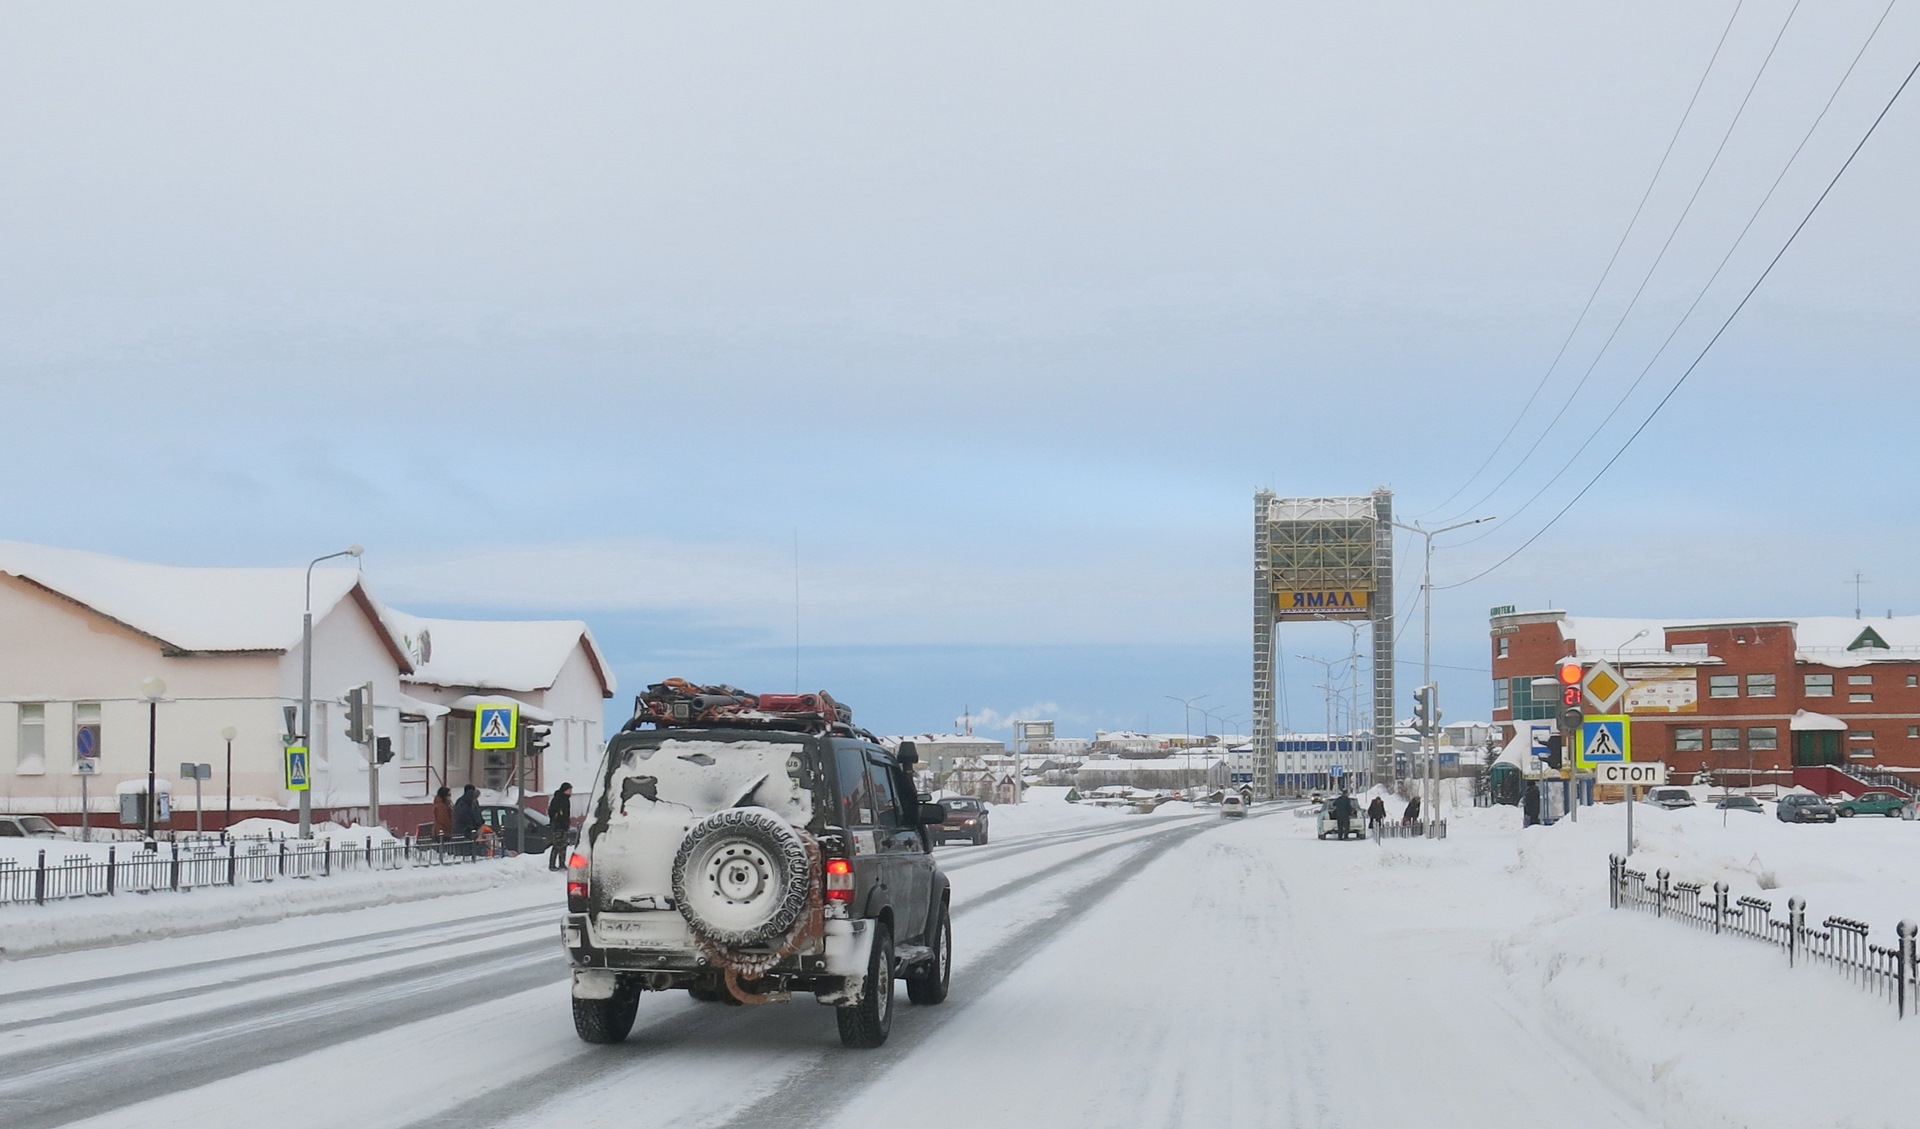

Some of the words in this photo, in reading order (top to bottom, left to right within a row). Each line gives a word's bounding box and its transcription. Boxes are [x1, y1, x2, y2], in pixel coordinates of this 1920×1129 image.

[1292, 592, 1355, 607] ЯМАЛ
[1565, 689, 1581, 705] 21
[1606, 766, 1655, 781] СТОП
